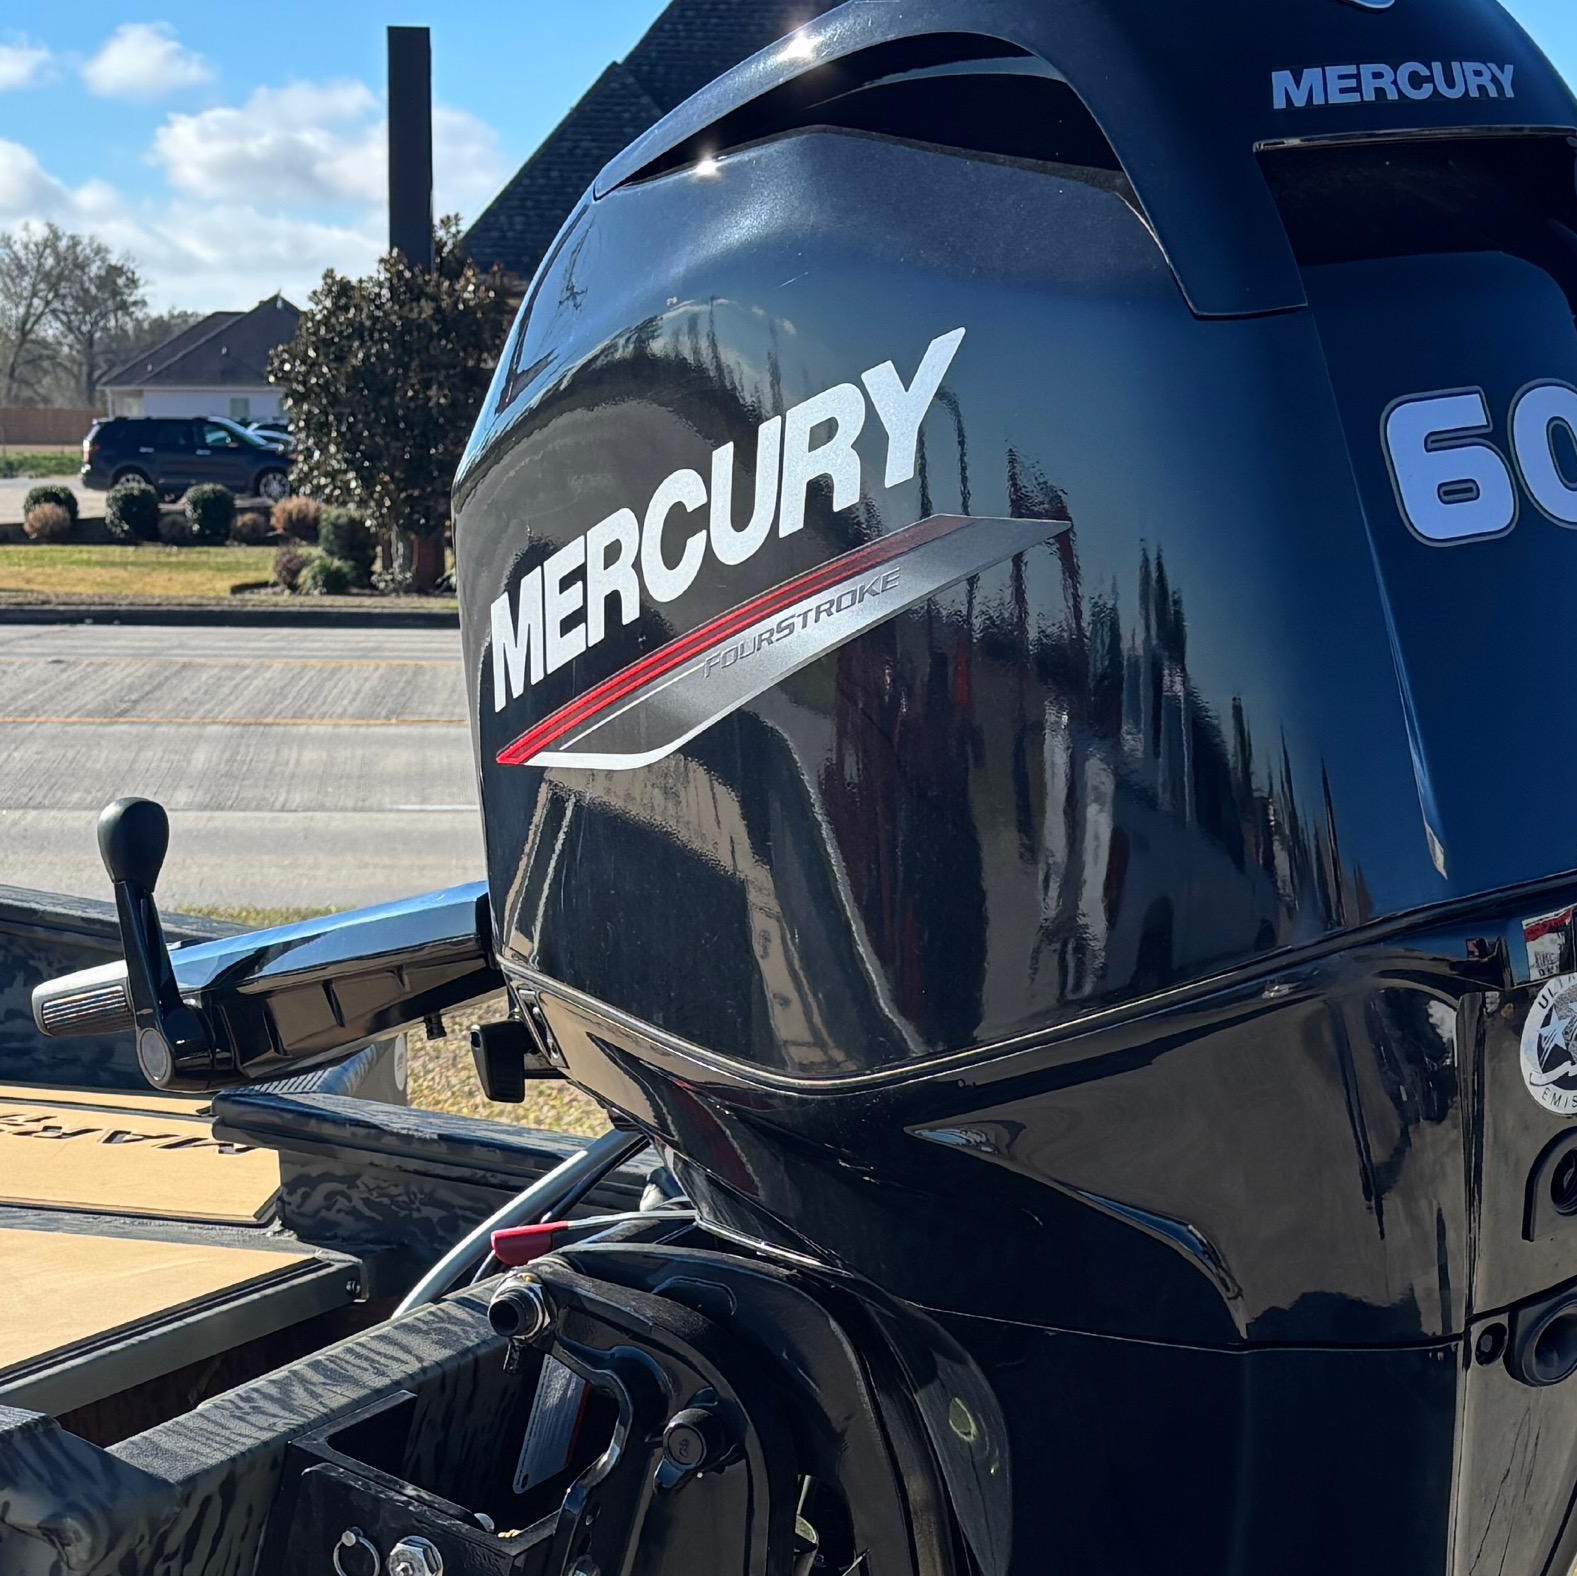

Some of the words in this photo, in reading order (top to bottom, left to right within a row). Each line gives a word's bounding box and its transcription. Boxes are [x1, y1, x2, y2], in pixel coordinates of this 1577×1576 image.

[1272, 61, 1514, 109] MERCURY
[490, 327, 966, 712] MERCURY
[704, 567, 901, 678] FOURSTROKE
